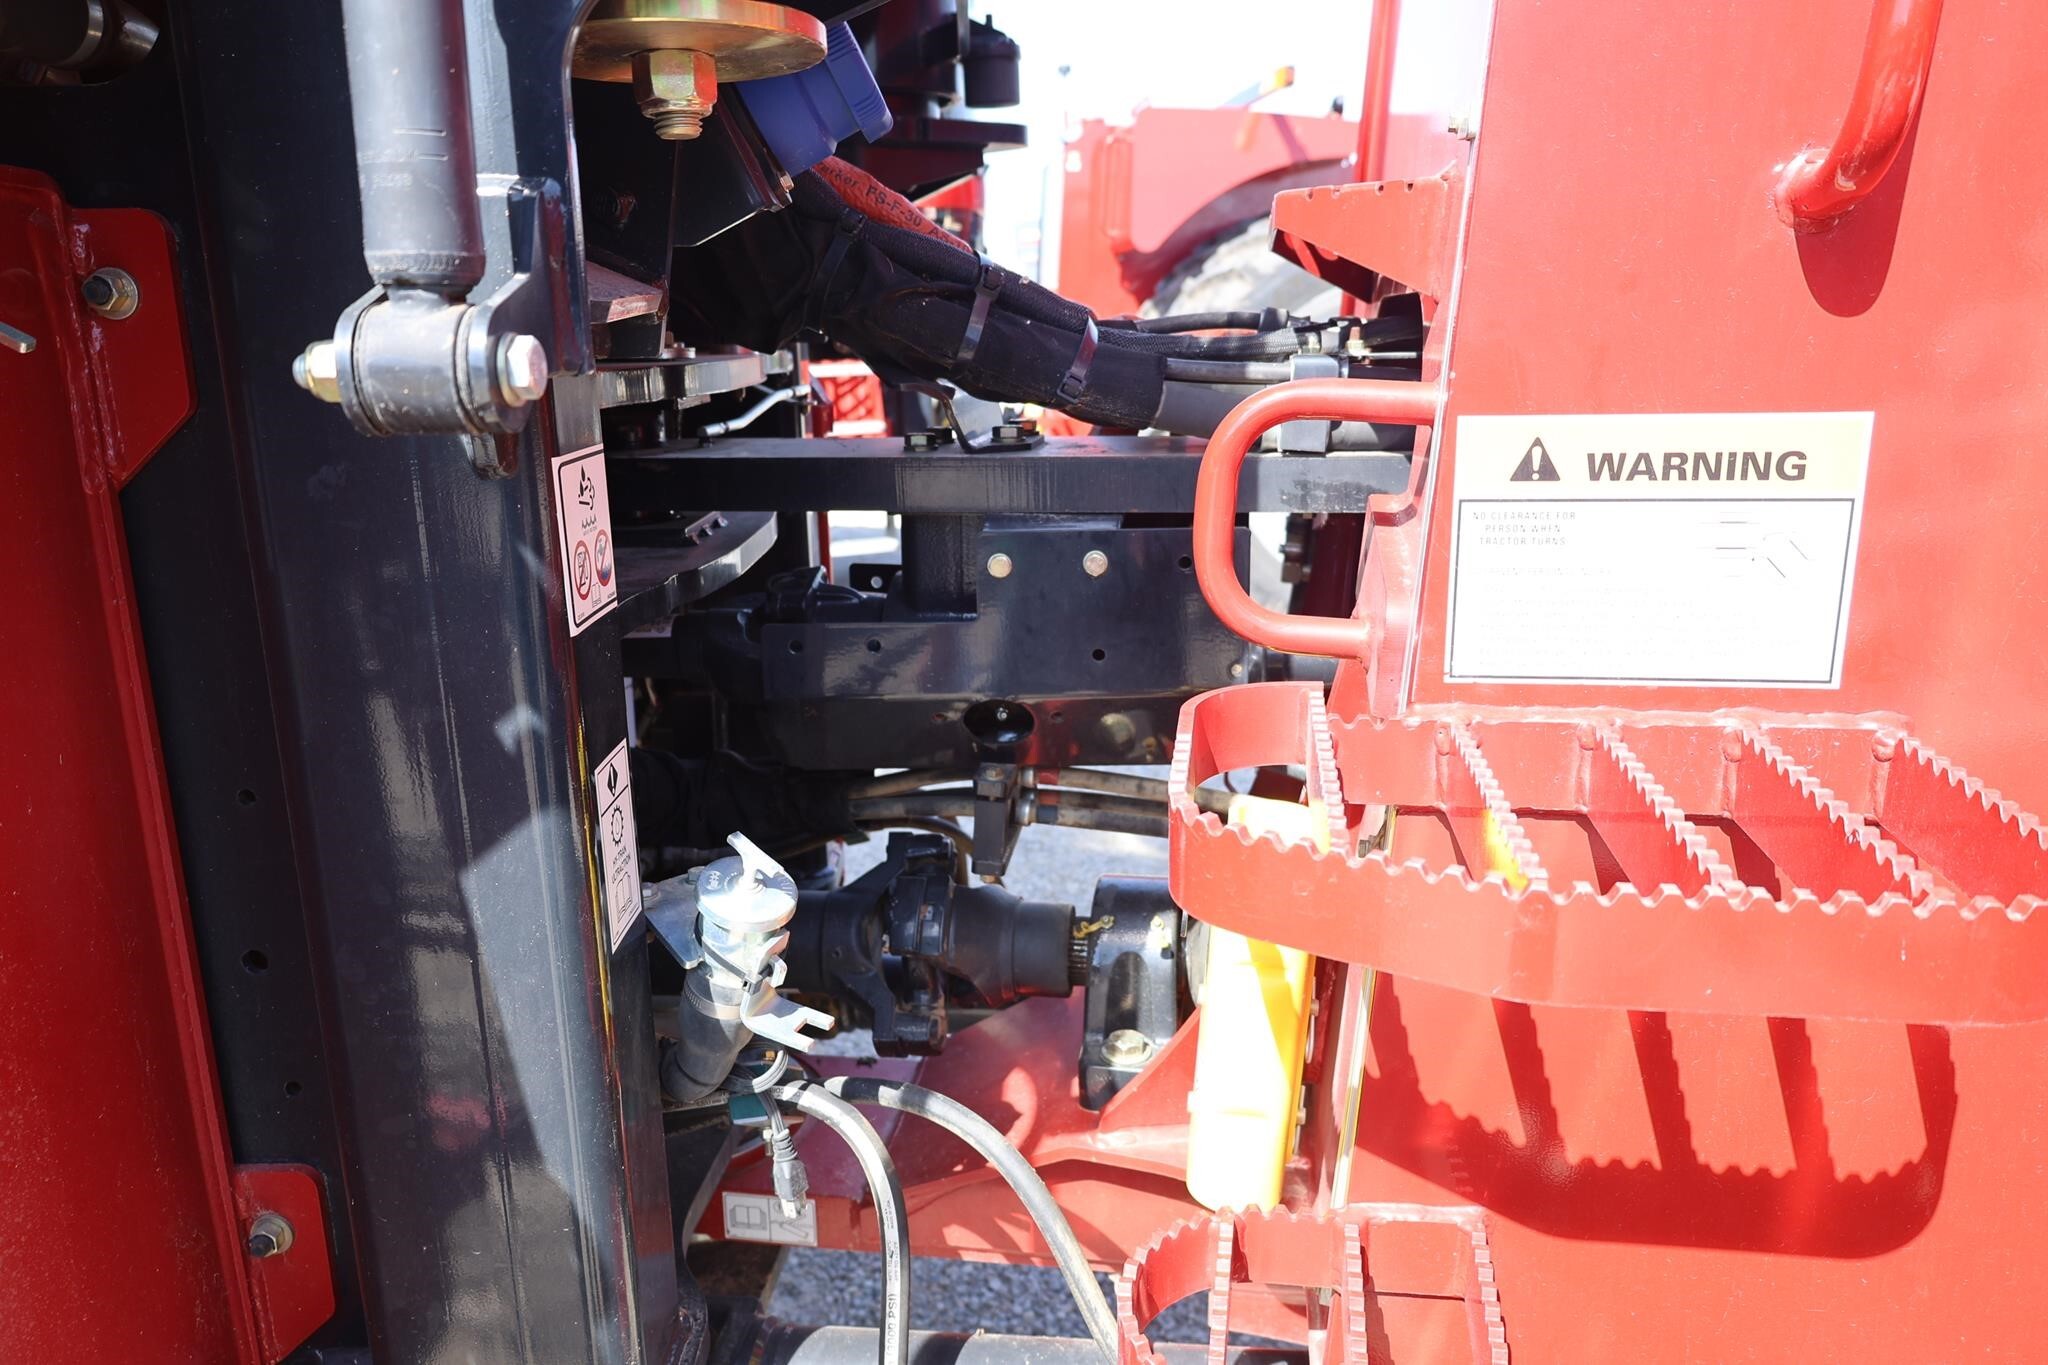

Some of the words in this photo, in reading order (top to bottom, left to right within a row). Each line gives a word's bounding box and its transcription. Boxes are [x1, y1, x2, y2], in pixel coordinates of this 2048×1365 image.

[866, 186, 922, 227] PS-F-30
[1586, 450, 1808, 482] WARNING
[1473, 511, 1486, 520] NO
[1490, 511, 1550, 520] CLEARANCE
[1556, 511, 1576, 520] FOR
[1484, 524, 1526, 533] PERSON
[1531, 524, 1560, 533] WHEN
[1480, 536, 1526, 546] TRACTOR
[1532, 536, 1567, 546] TURNS
